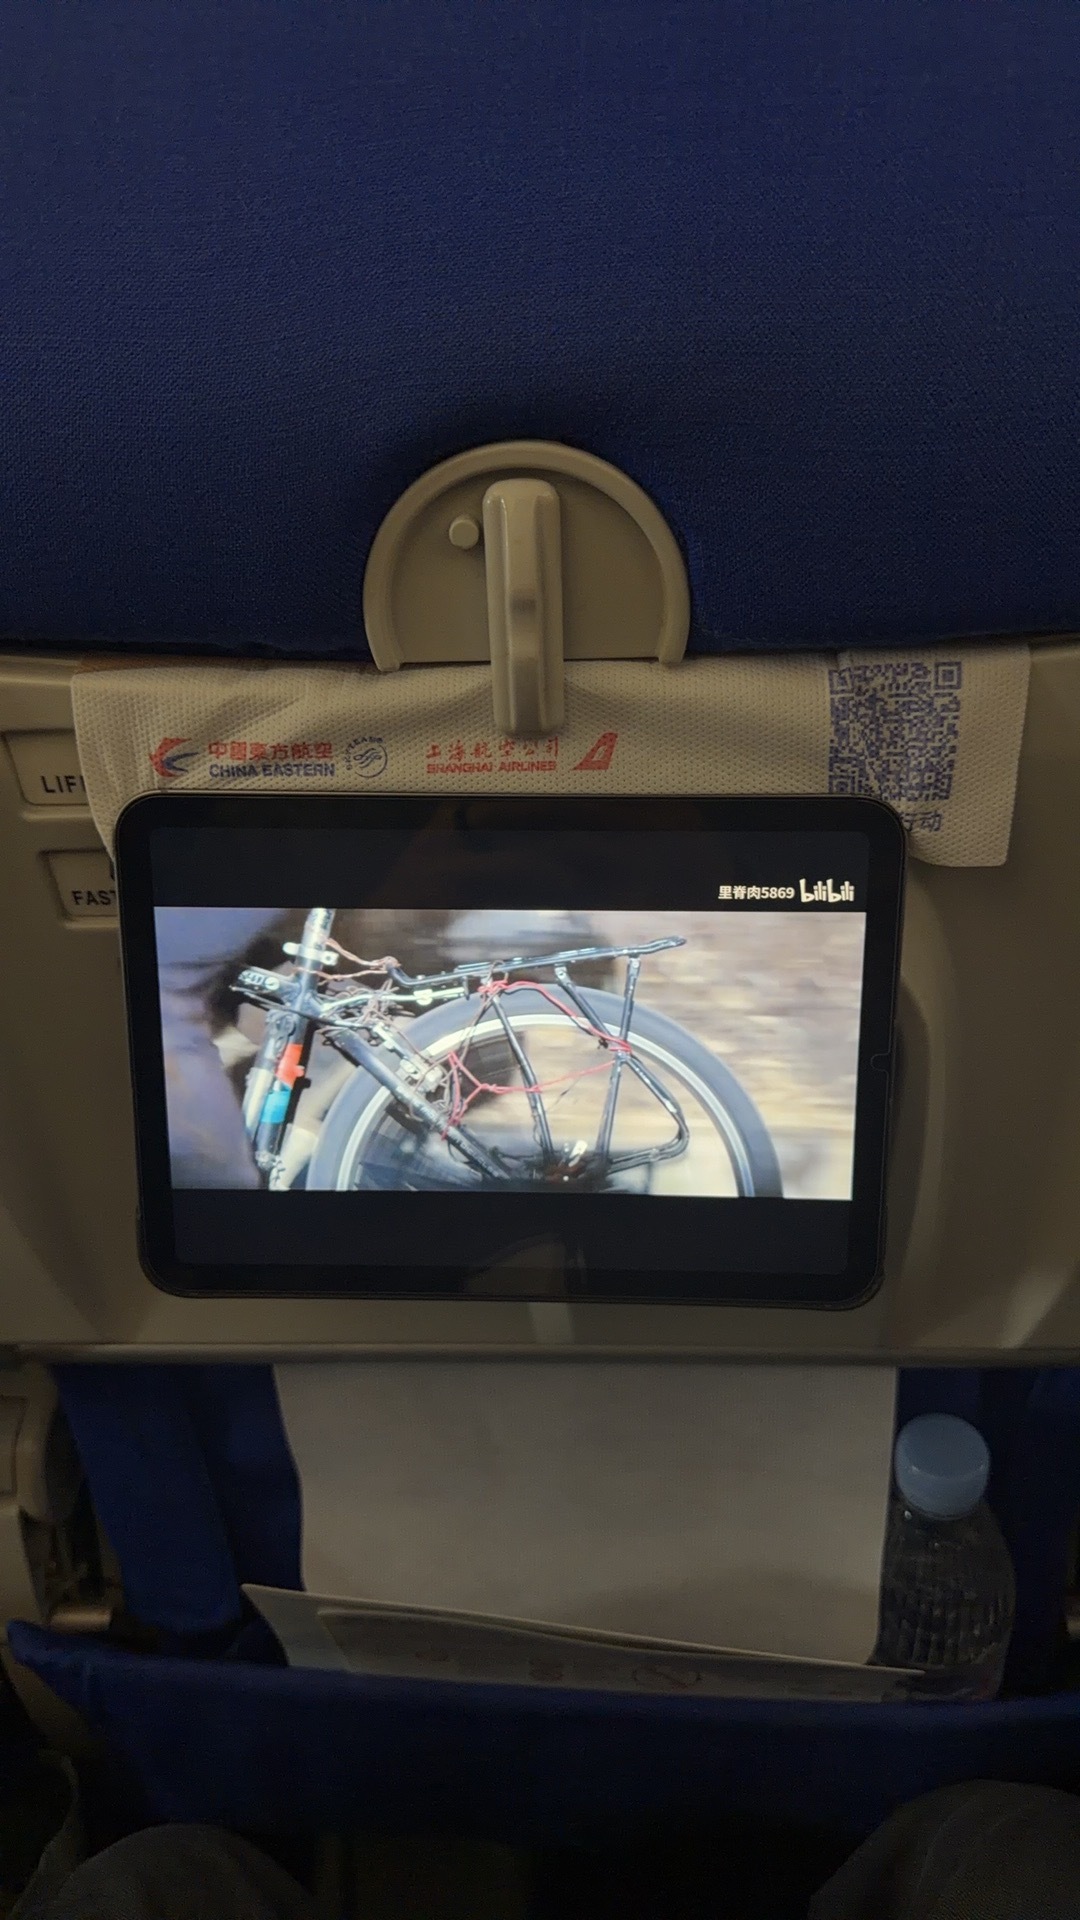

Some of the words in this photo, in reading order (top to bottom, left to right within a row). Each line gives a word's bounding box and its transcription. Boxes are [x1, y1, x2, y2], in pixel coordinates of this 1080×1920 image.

[209, 764, 258, 778] CHINA
[263, 762, 335, 777] EASTERN
[426, 761, 493, 774] SHANGHAI
[498, 760, 557, 773] AIRLINES
[718, 885, 795, 900] 里脊肉5869
[799, 878, 855, 903] bilibili
